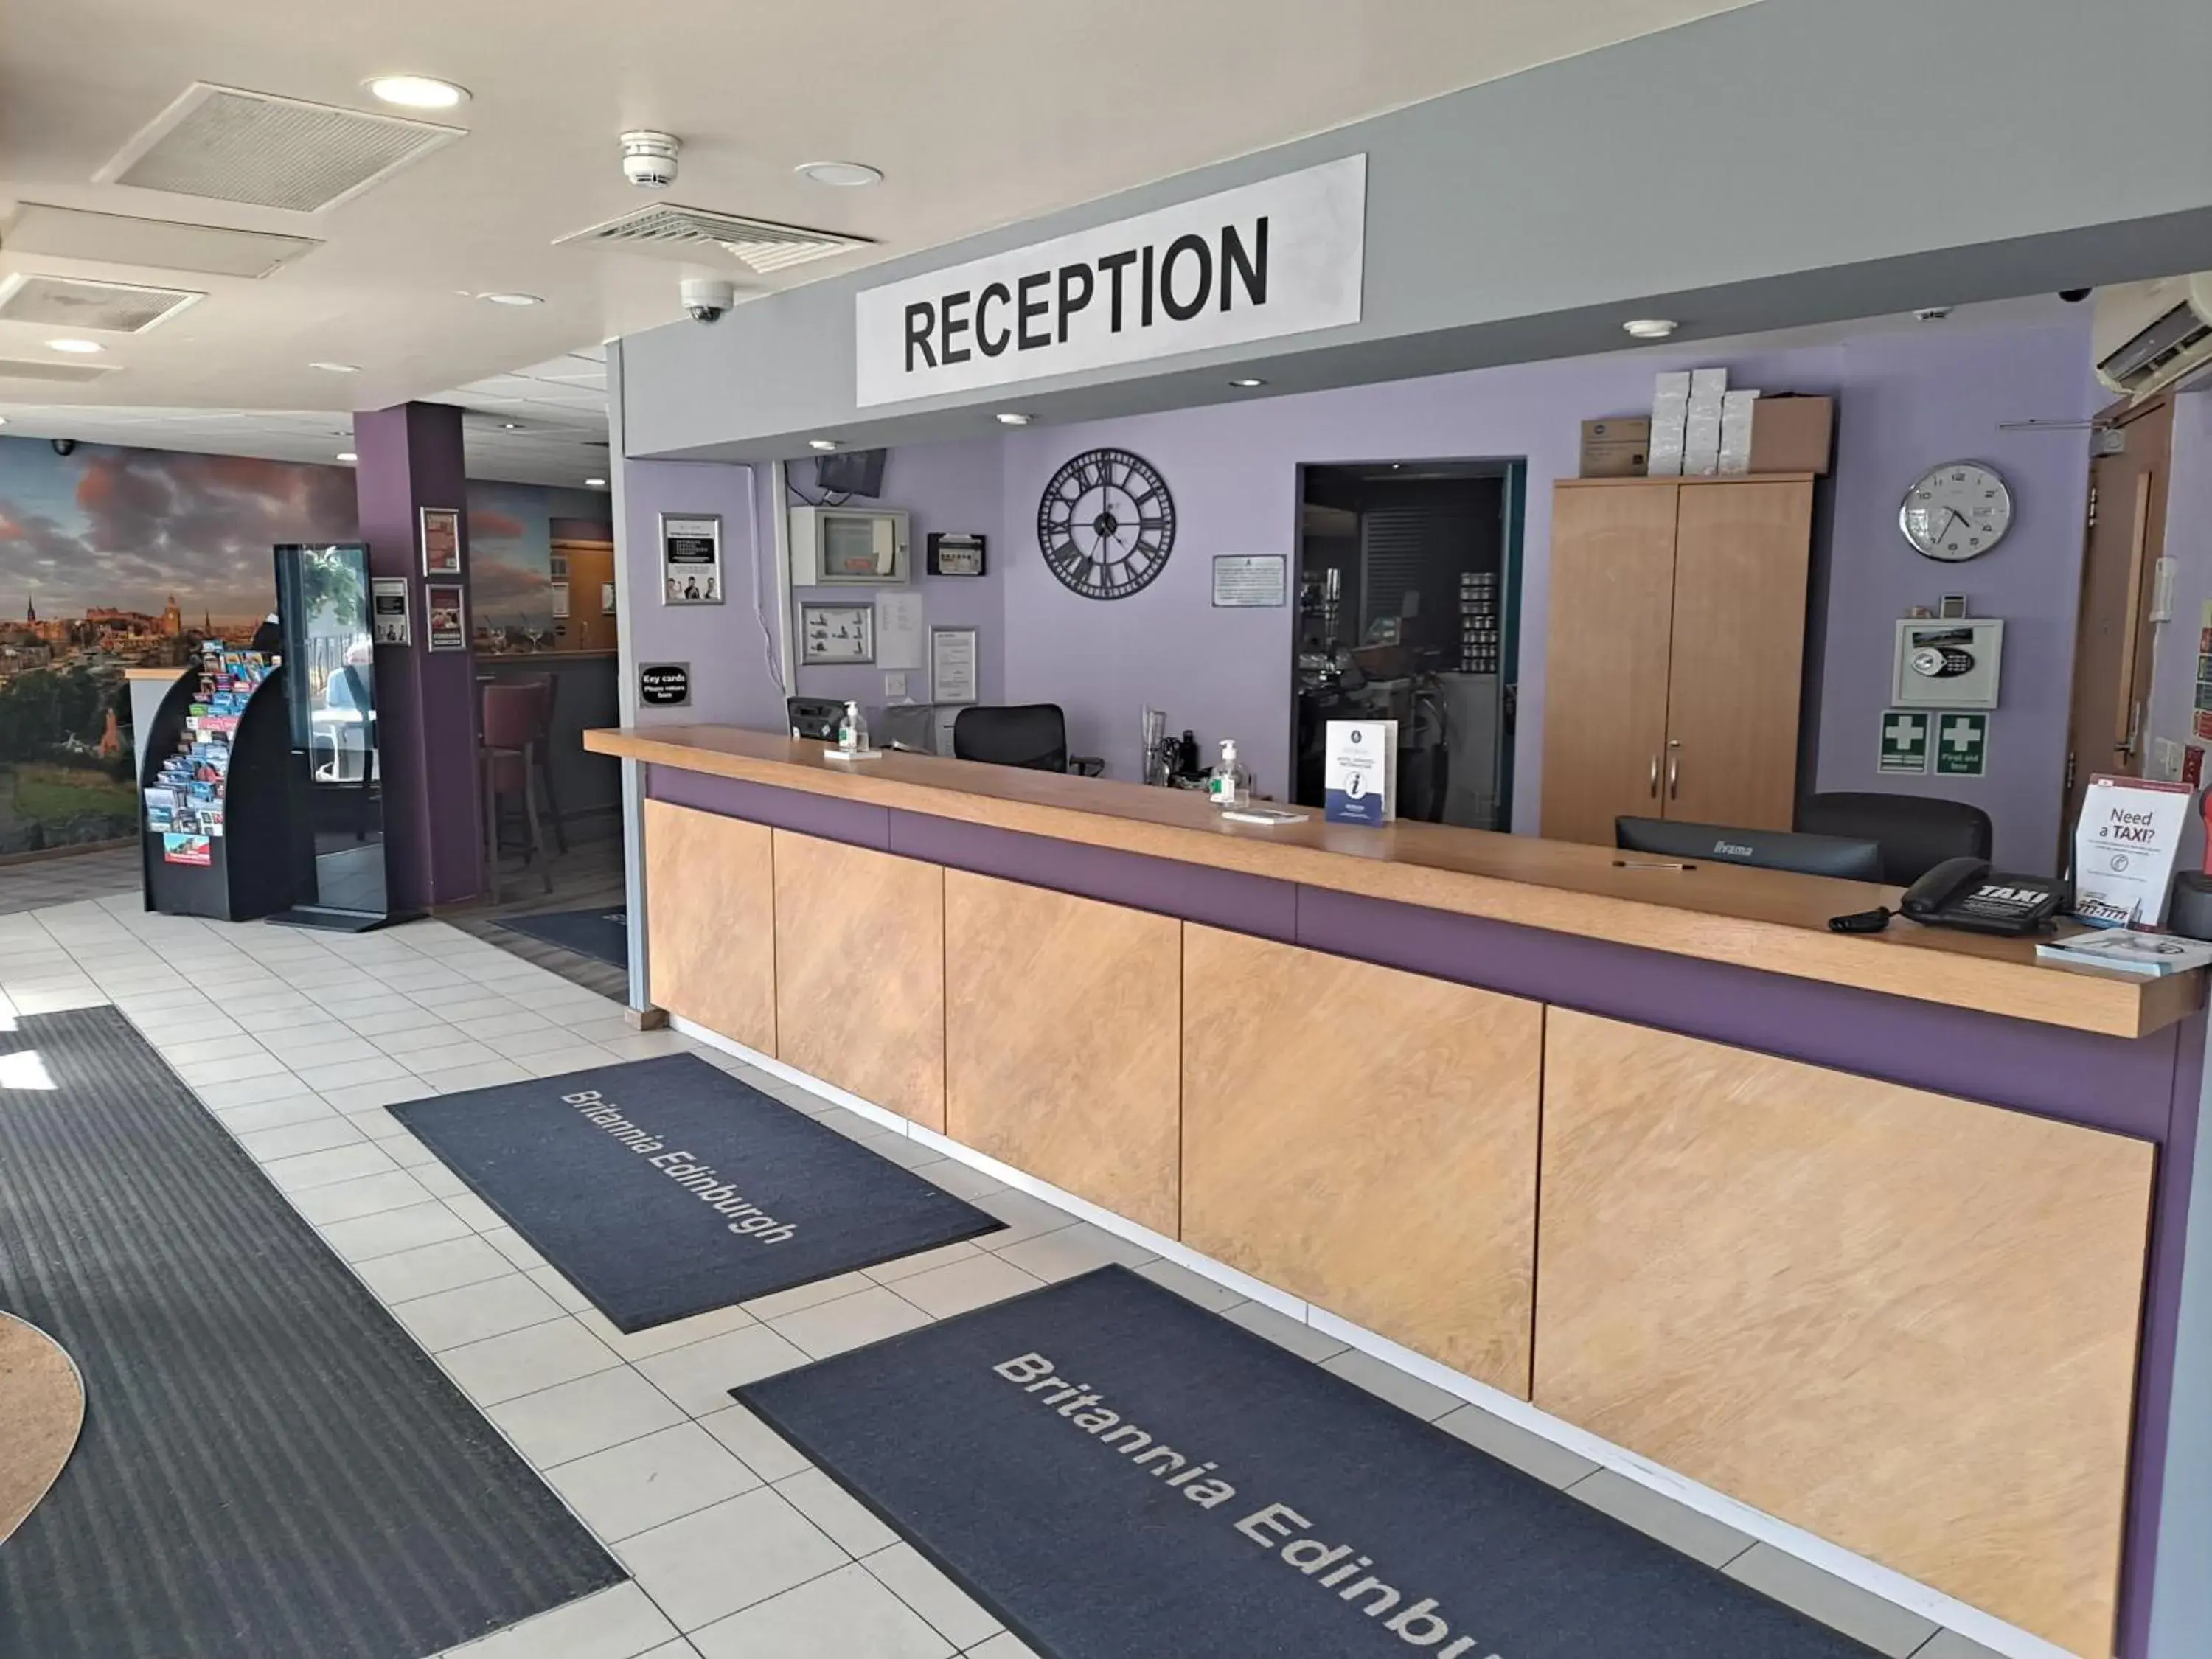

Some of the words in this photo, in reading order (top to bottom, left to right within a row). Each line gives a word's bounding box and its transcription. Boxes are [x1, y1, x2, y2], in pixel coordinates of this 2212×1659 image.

[905, 217, 1268, 372] RECEPTION
[644, 675, 661, 684] Key
[662, 673, 685, 682] cards
[2111, 808, 2153, 826] Need
[2099, 827, 2108, 837] a
[2113, 825, 2155, 844] TAXI?
[1977, 885, 2049, 904] TAXI
[561, 1091, 664, 1154] Britannia
[649, 1151, 798, 1245] Edinburgh
[992, 1352, 1235, 1509] Britannia
